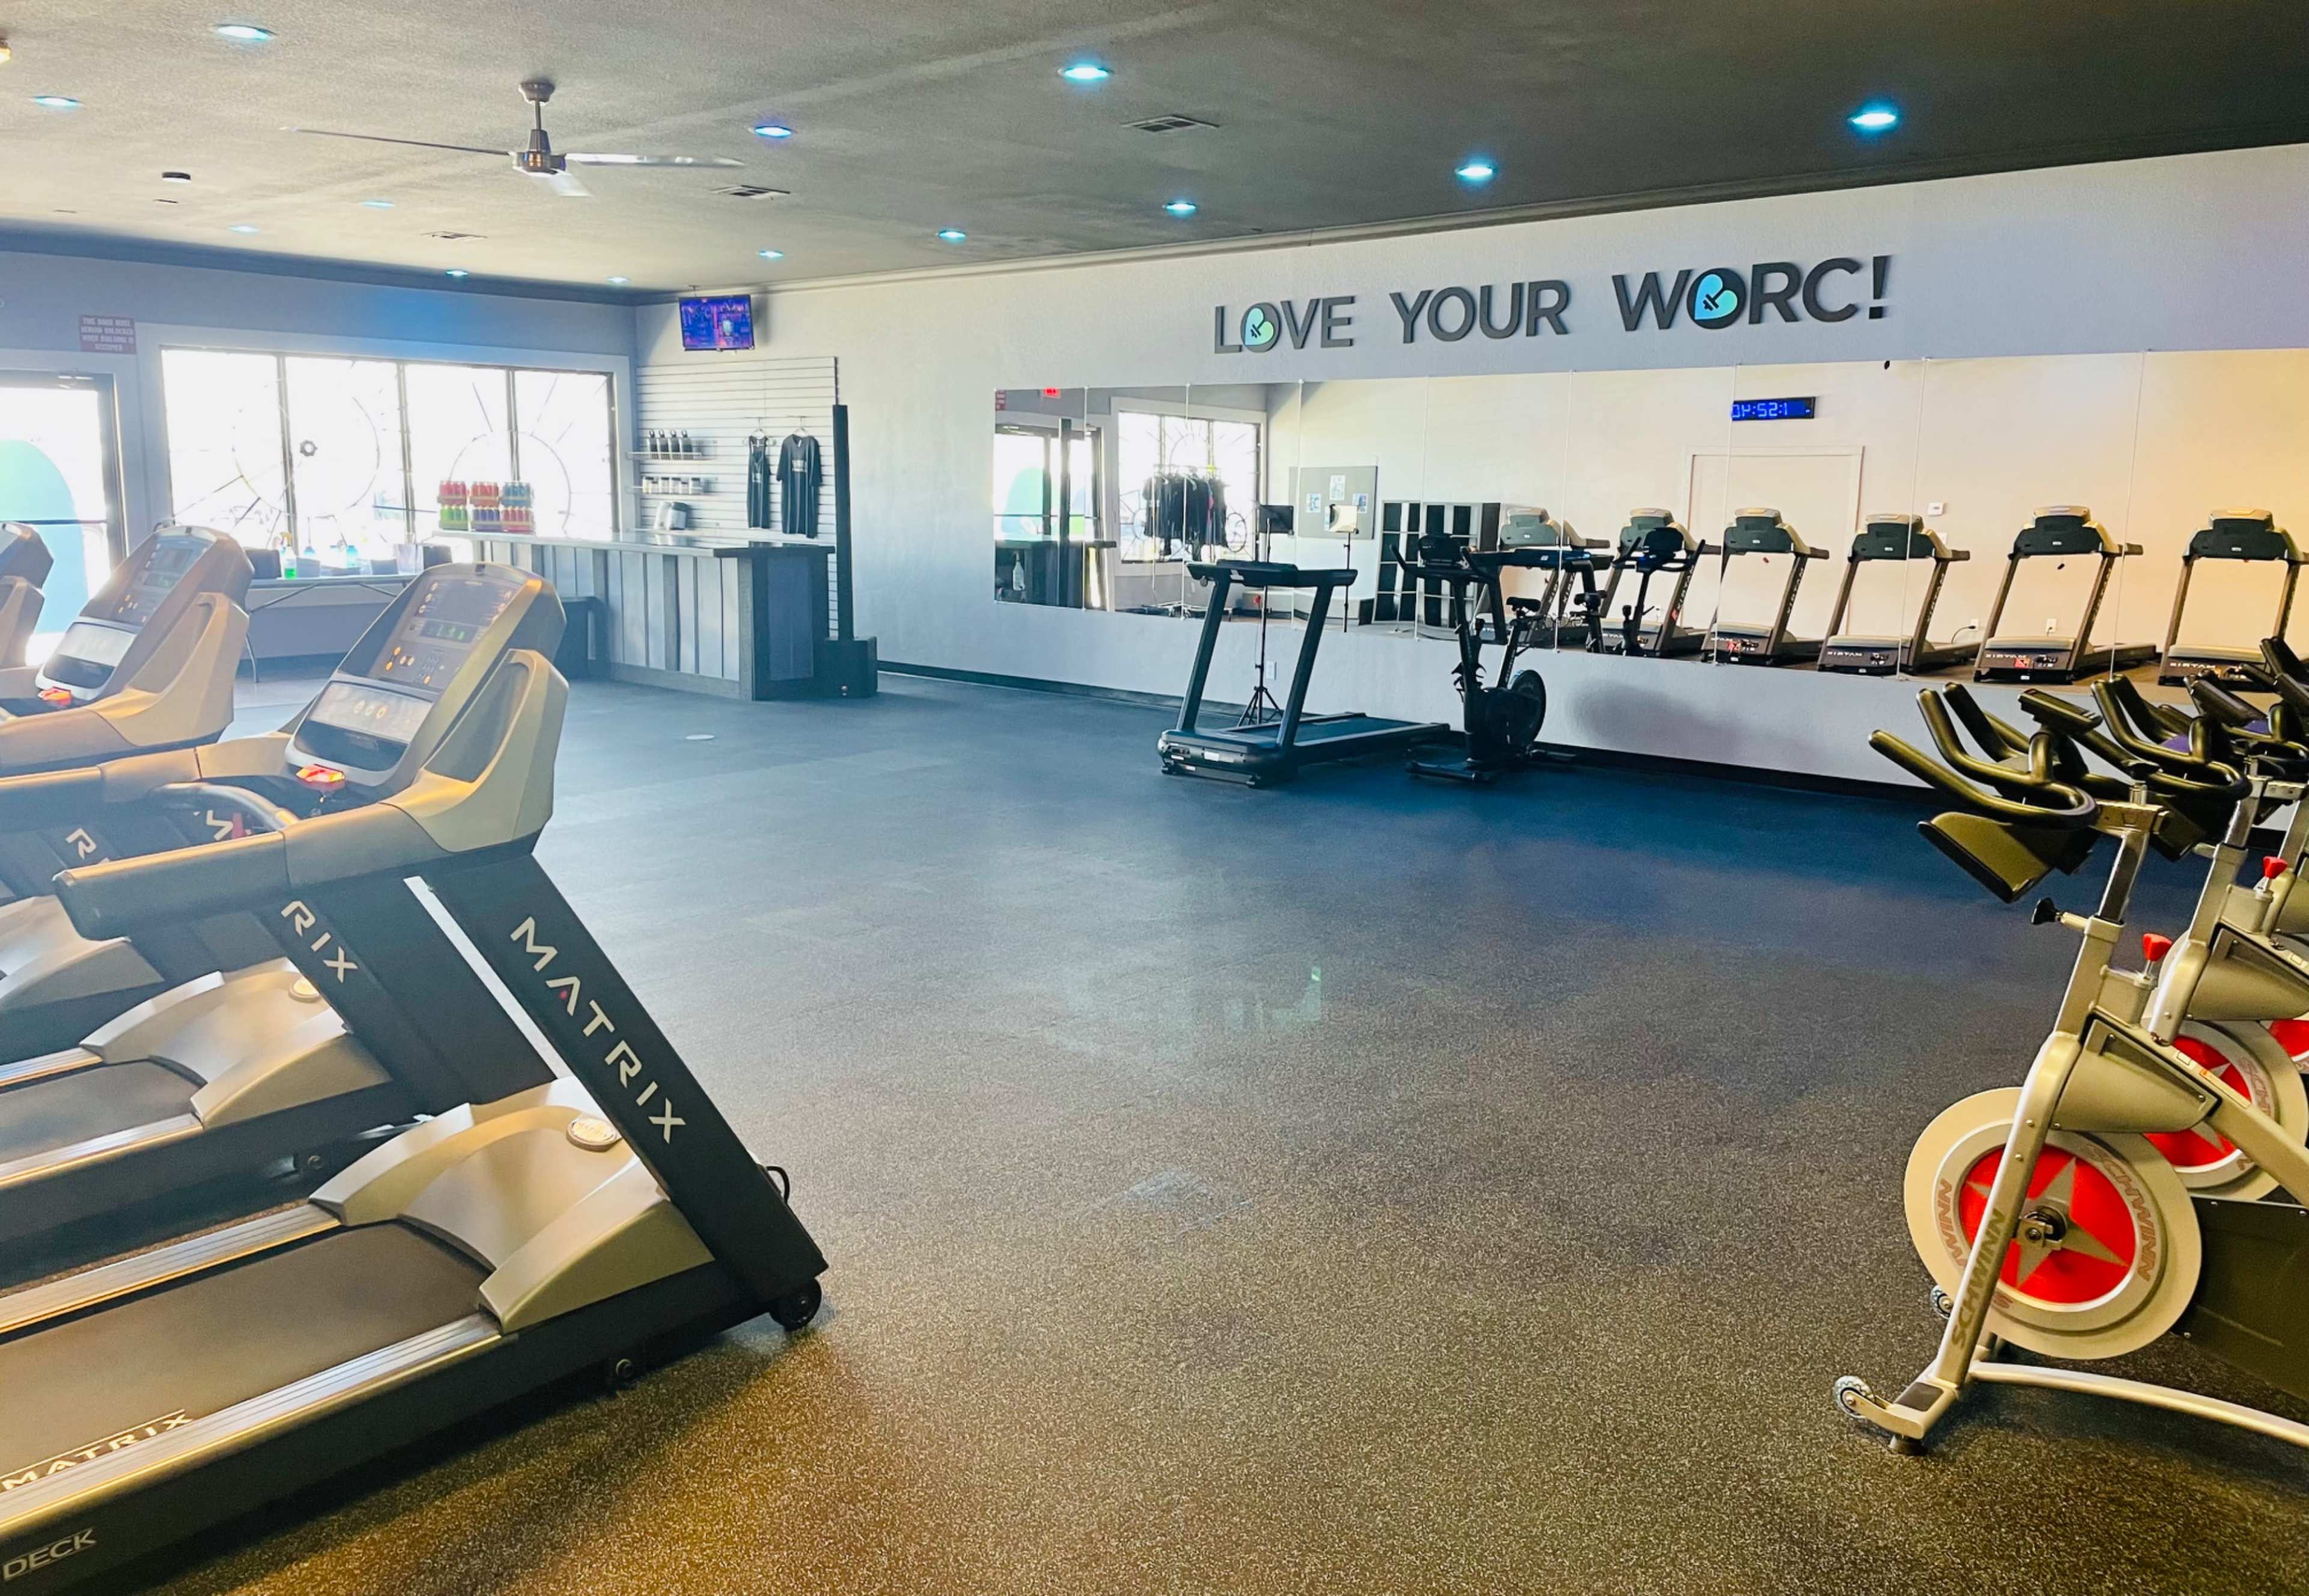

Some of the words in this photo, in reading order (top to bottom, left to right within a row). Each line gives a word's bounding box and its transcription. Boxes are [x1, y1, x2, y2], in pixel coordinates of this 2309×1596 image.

[1214, 295, 1356, 353] LOVE
[1389, 280, 1572, 344] YOUR
[1611, 255, 1892, 332] WORC!
[281, 900, 358, 983] RIX
[510, 917, 686, 1144] MATRIX
[2078, 1142, 2157, 1282] SCHWINN
[1951, 1208, 2005, 1349] SCHWINN
[1, 1414, 192, 1490] MATRIX
[2, 1527, 97, 1582] DECK
